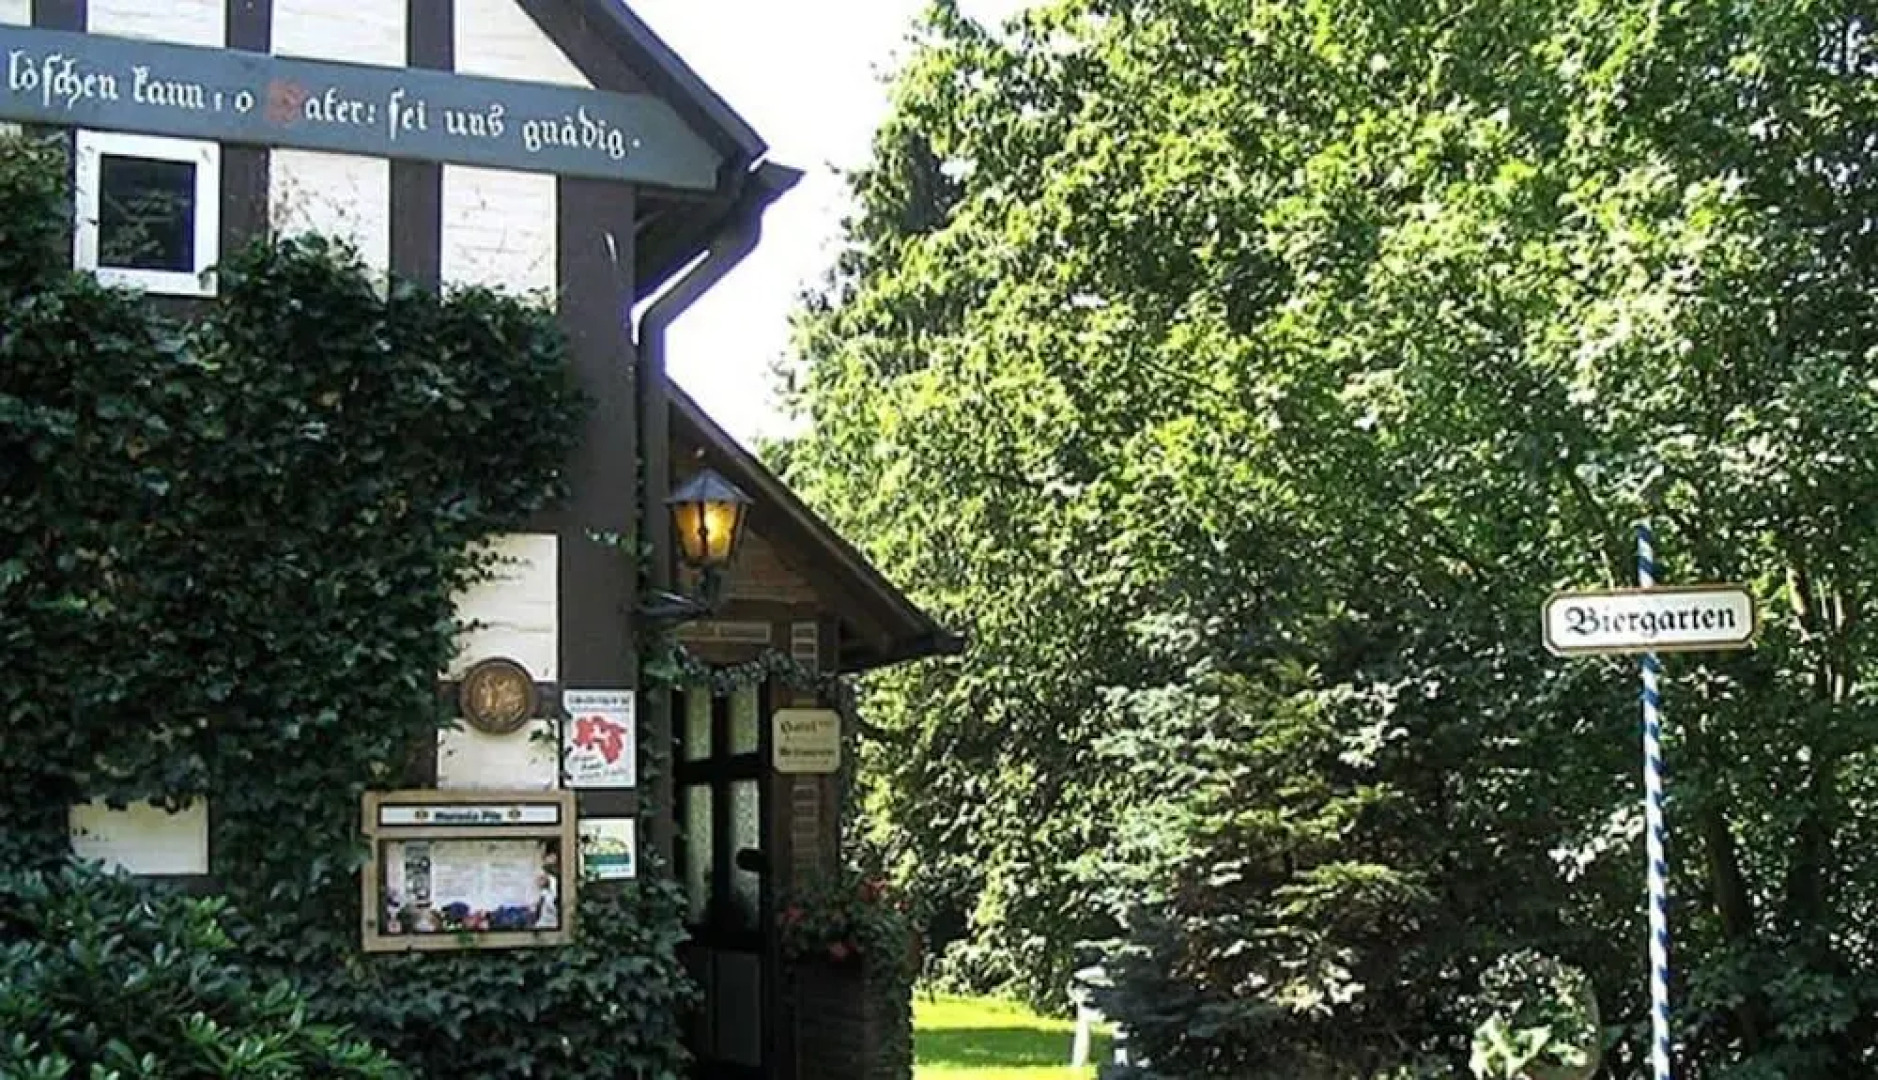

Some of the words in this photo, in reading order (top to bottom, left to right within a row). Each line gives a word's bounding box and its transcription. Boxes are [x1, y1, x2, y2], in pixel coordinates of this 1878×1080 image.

[235, 90, 255, 113] o
[444, 104, 505, 137] uns
[1565, 603, 1736, 638] Biergarten
